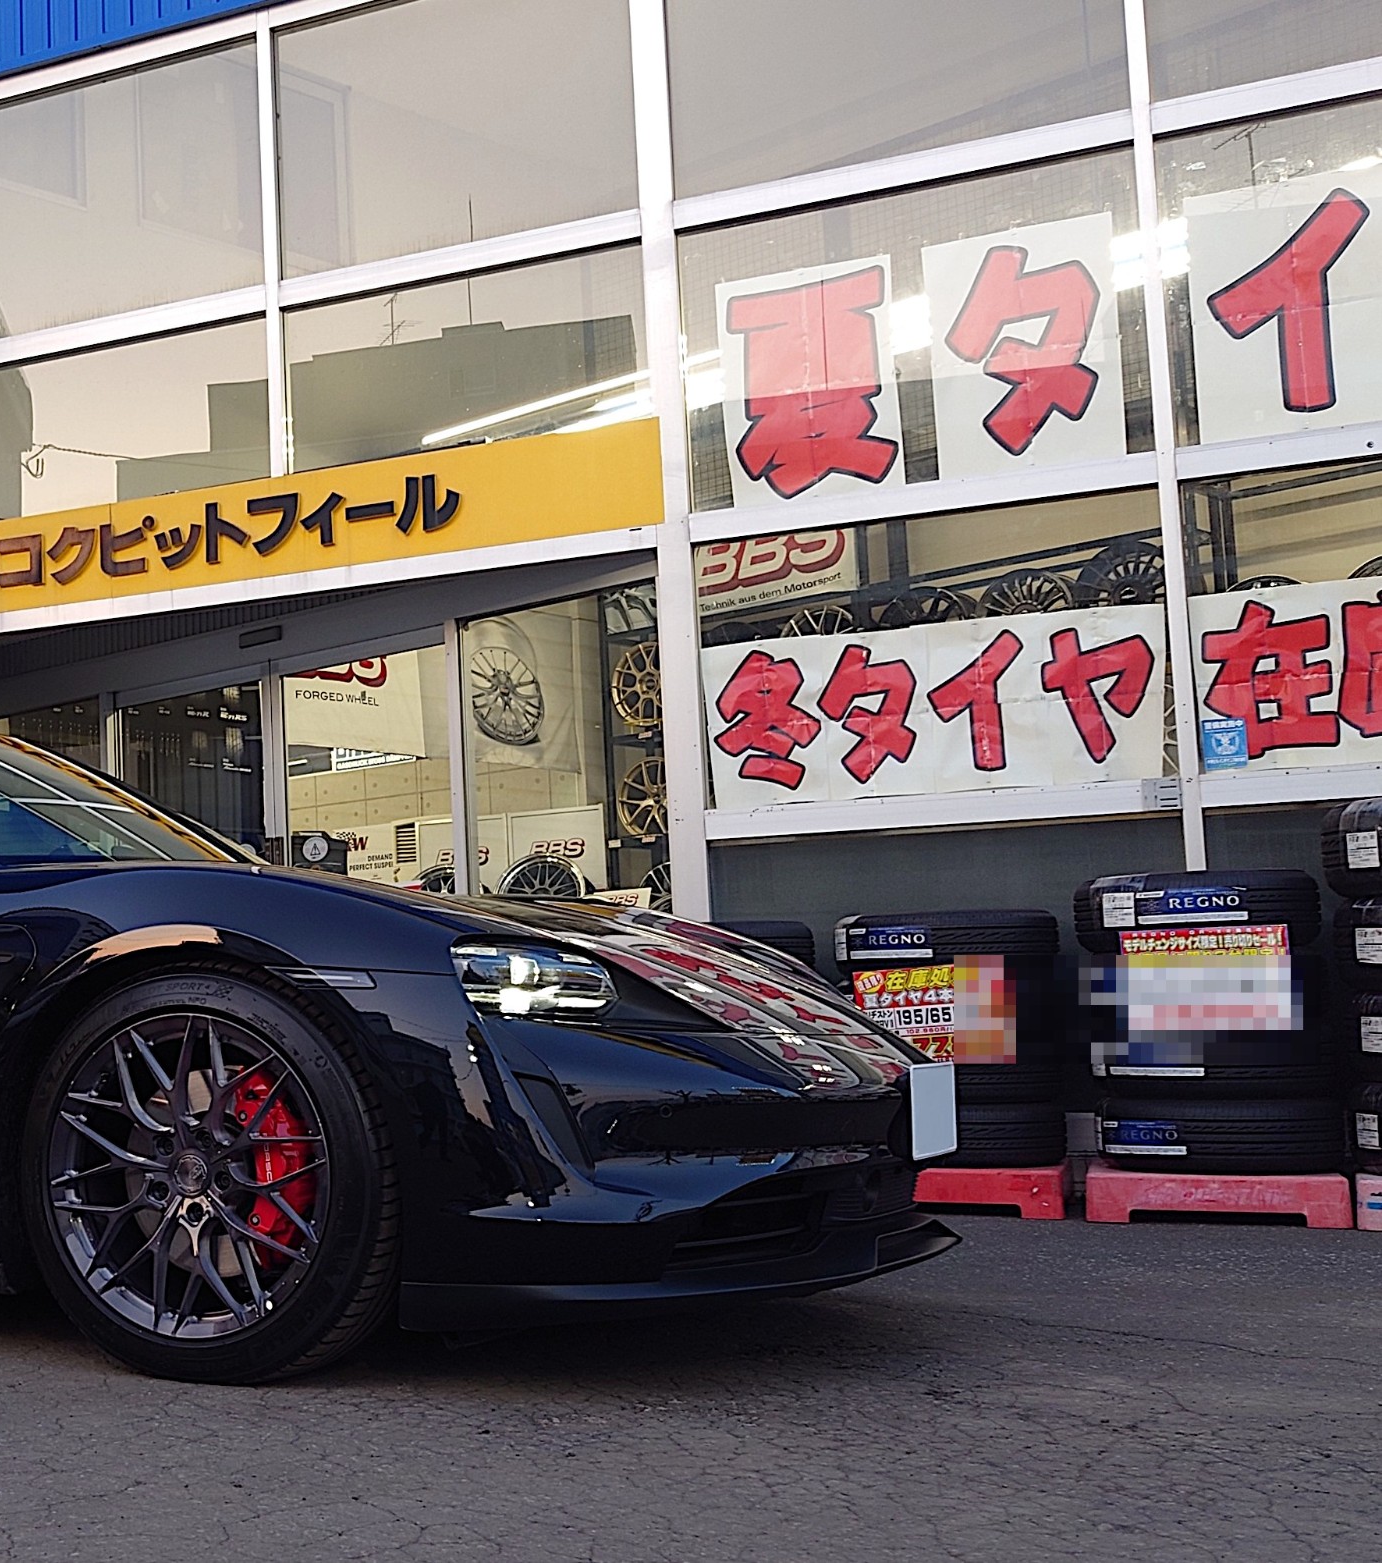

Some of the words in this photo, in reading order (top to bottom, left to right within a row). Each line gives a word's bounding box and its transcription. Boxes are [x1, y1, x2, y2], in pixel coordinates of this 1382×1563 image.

[696, 529, 847, 598] BBS
[699, 598, 736, 612] Technik
[738, 594, 757, 604] aus
[759, 588, 782, 600] dem
[784, 571, 842, 595] Motorsport
[295, 689, 344, 703] FORGED
[713, 628, 1156, 791] 冬タイヤ
[367, 853, 393, 862] DEMAND
[349, 863, 373, 872] PERFECT
[1168, 895, 1241, 909] REGNO
[868, 933, 926, 946] REGNO
[885, 966, 954, 992] 在庫処
[896, 1008, 954, 1027] 195/65
[912, 1035, 954, 1055] 77
[1120, 1129, 1178, 1141] REGNO
